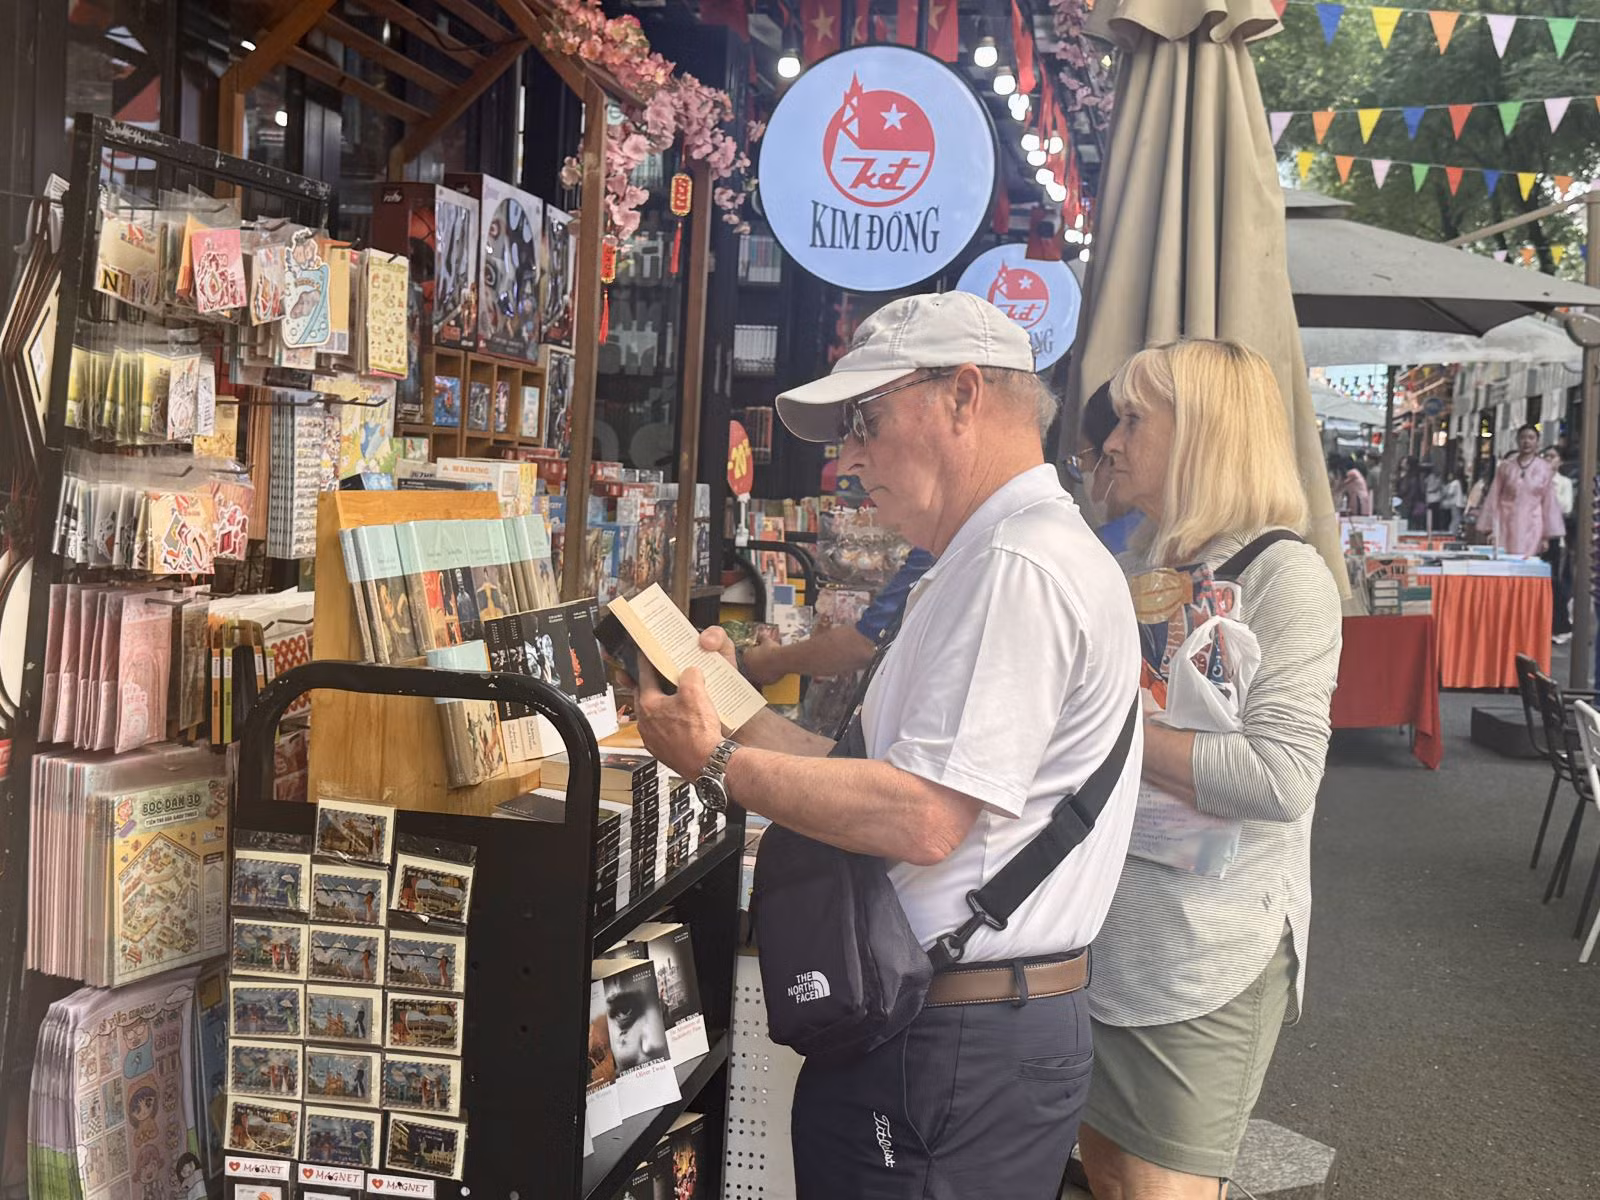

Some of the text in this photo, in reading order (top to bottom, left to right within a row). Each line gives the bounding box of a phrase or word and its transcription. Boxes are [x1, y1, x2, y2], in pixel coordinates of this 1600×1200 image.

[809, 200, 860, 251] KIM
[796, 971, 813, 984] THE
[787, 981, 815, 998] NORTH
[796, 991, 817, 1004] FACE
[641, 1057, 666, 1069] DICKENS
[243, 1163, 285, 1175] MAGNET
[315, 1170, 360, 1184] MAGNET
[386, 1180, 429, 1194] MAGNET
